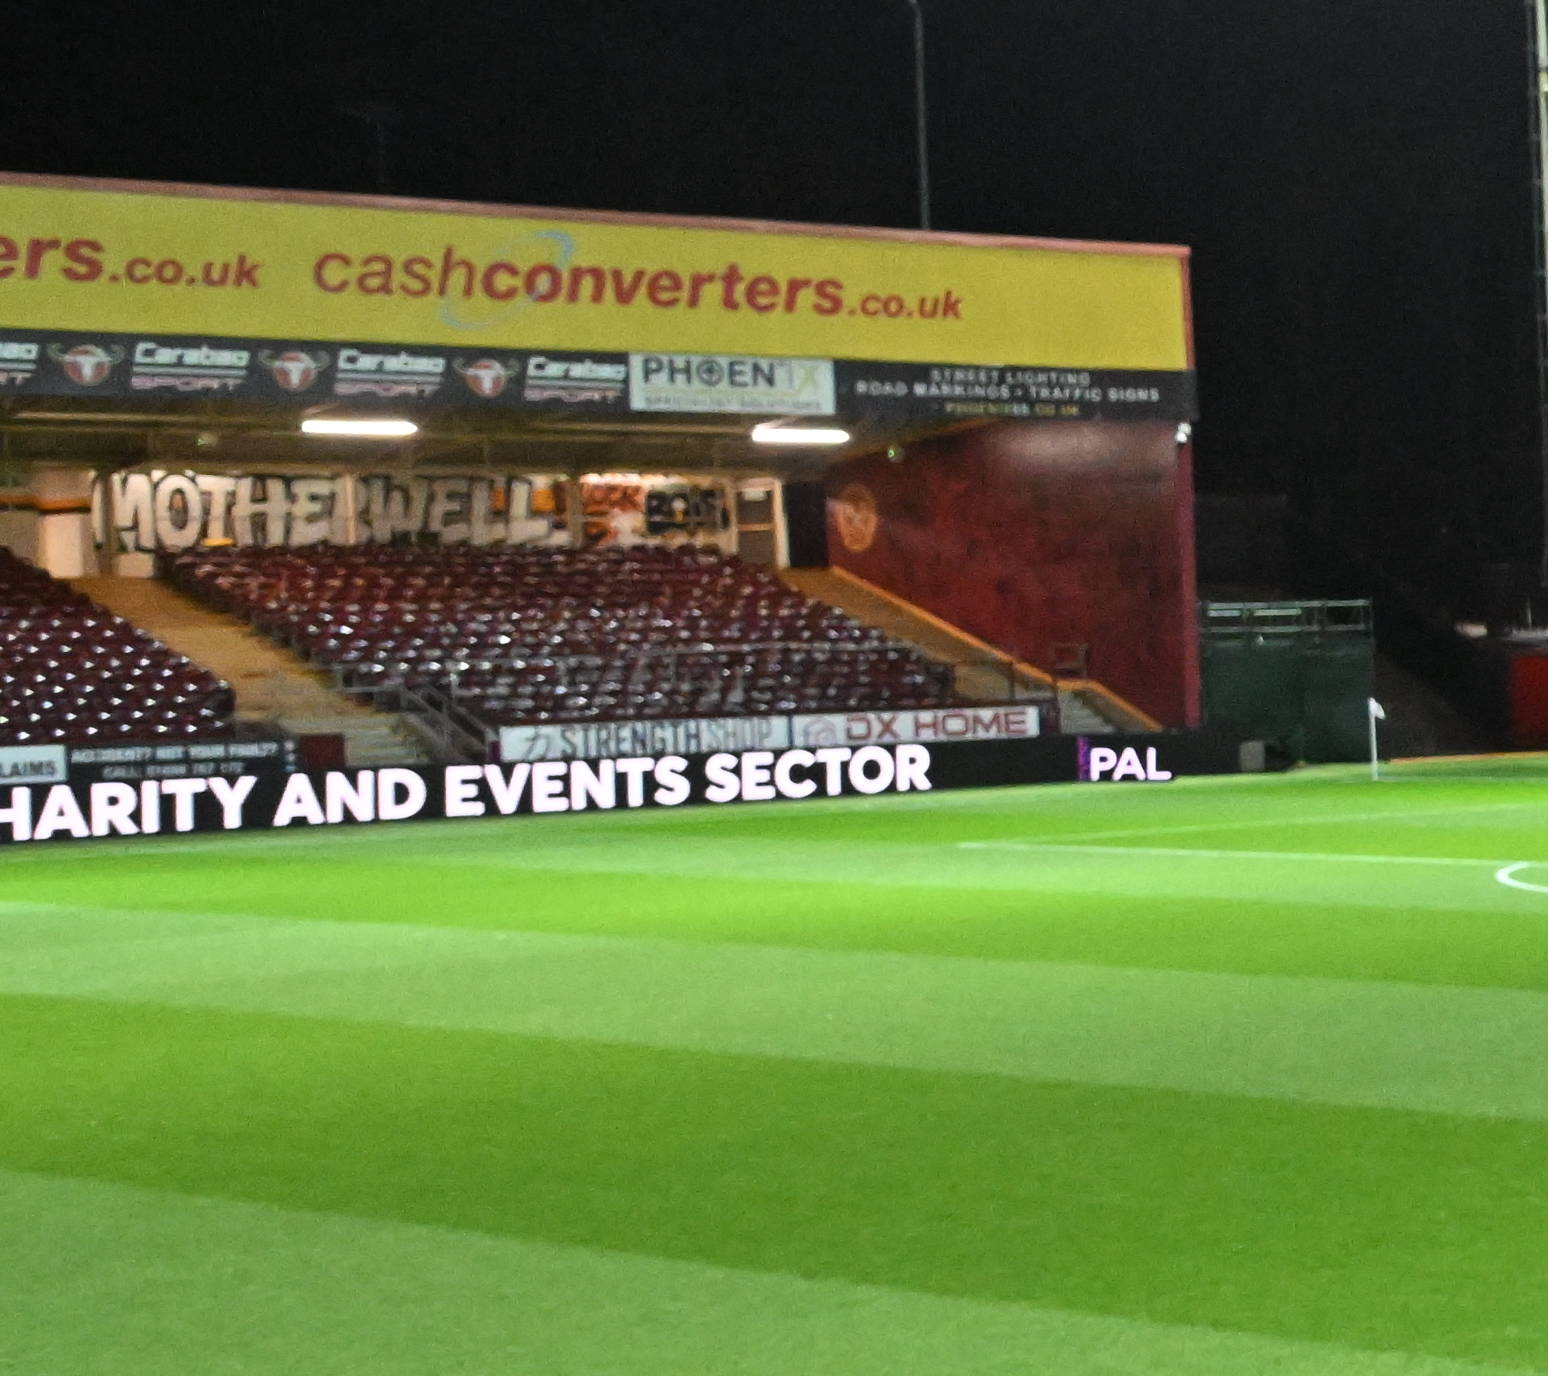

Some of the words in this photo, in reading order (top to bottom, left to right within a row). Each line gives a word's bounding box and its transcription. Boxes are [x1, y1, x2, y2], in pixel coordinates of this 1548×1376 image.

[313, 244, 963, 321] cashconverters.co.uk
[845, 713, 897, 740] DX
[914, 709, 1028, 737] HOME
[273, 767, 428, 827] AND
[444, 755, 692, 818] EVENTS
[705, 744, 932, 804] SECTOR
[1089, 746, 1172, 782] PAL
